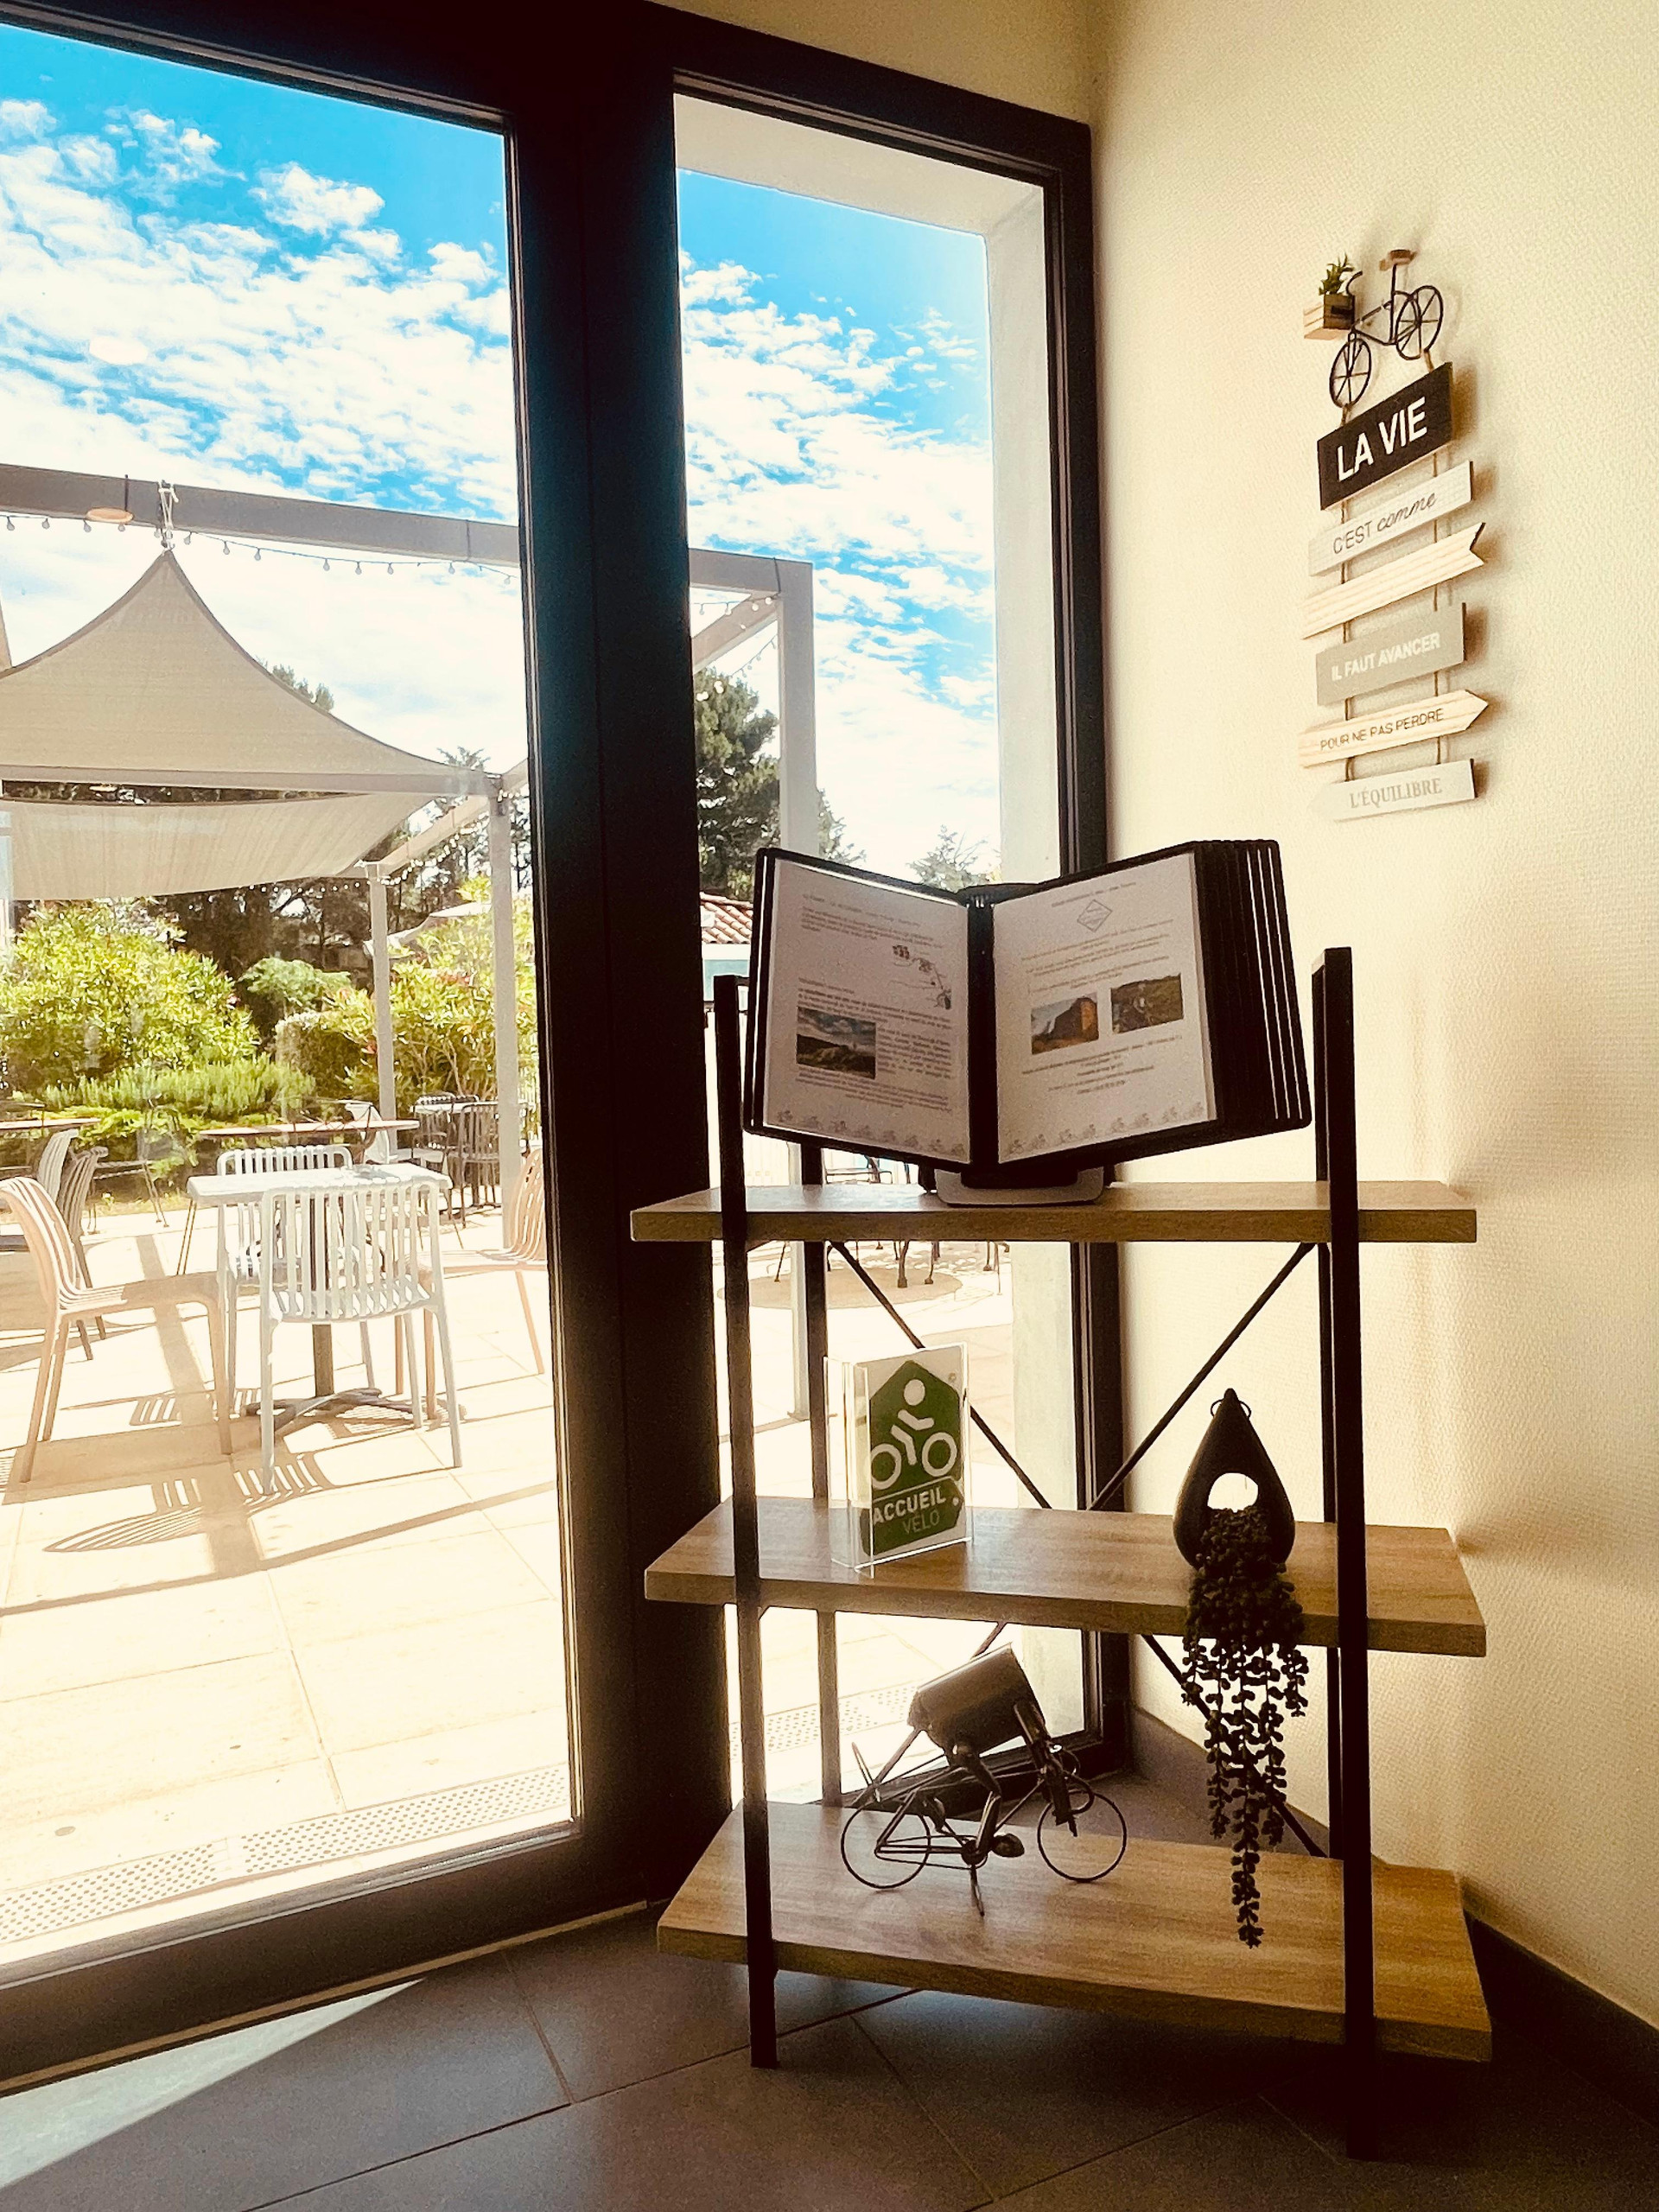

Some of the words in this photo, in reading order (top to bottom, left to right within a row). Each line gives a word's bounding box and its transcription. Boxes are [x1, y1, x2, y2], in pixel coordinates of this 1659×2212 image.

[1337, 432, 1374, 482] LA
[1378, 396, 1427, 455] VIE
[1332, 521, 1373, 555] C'EST
[1376, 493, 1437, 532] comme
[1331, 665, 1343, 682] IL
[1344, 653, 1376, 677] FAUT
[1377, 632, 1441, 668] AVANCER
[1319, 736, 1350, 751] POUR
[1351, 729, 1368, 742] NE
[1370, 722, 1394, 738] PAS
[1395, 709, 1445, 731] PERDRE
[1349, 778, 1443, 809] L'ÉQUILIBRE
[873, 1486, 947, 1525] ACCUEIL
[901, 1507, 941, 1535] VÉLO
